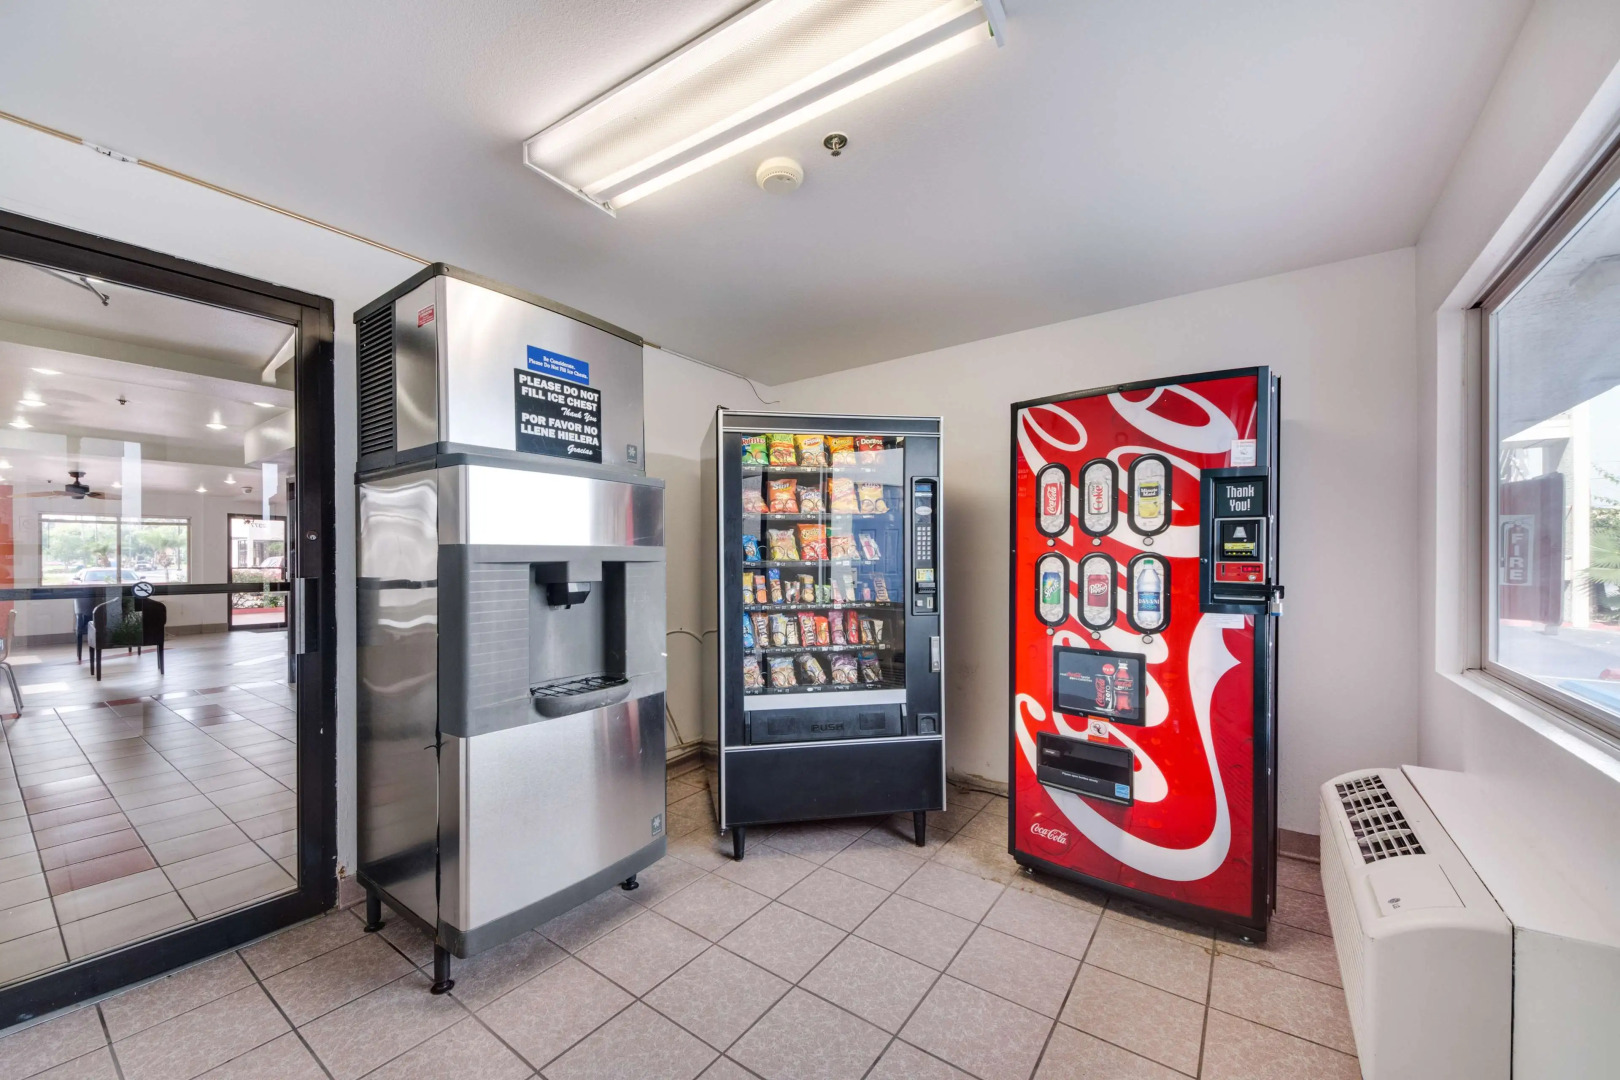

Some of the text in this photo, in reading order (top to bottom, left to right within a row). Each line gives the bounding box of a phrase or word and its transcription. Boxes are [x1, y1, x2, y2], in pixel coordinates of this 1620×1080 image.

[528, 358, 543, 366] Please
[519, 374, 598, 401] PLEASE DO NOT
[522, 386, 597, 411] FILL ICE CHEST
[561, 407, 597, 422] Thank You
[522, 413, 598, 435] POR FAVOR NO
[521, 424, 599, 446] LLENE HIELERA
[567, 444, 593, 455] Gracias
[1093, 485, 1103, 510] Coke
[1226, 485, 1254, 498] Thank
[1230, 499, 1250, 511] You!
[1509, 533, 1524, 580] FIRE
[1044, 580, 1060, 598] Sprite
[810, 723, 844, 732] PUSH
